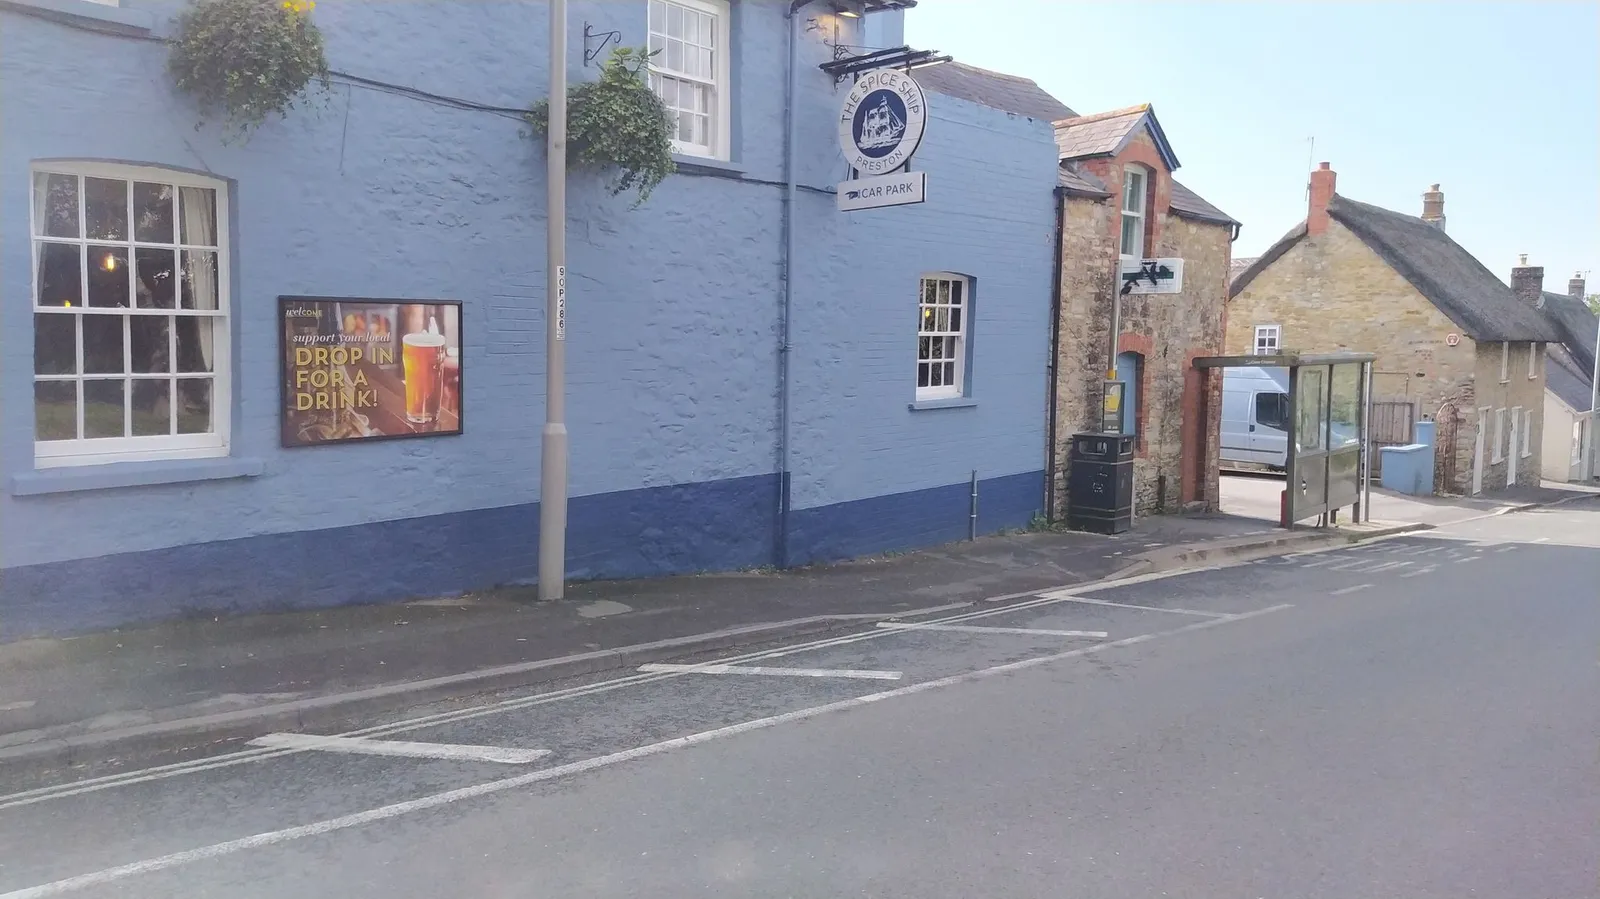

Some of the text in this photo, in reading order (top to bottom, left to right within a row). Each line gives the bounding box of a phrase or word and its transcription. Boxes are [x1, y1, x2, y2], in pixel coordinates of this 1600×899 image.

[841, 72, 920, 124] THE SPICE SHIP
[855, 149, 903, 171] PRESTON
[861, 182, 913, 199] CAR PARK
[292, 331, 391, 346] support your local
[295, 347, 393, 366] DROP IN
[296, 368, 368, 389] FOR A
[296, 389, 379, 411] DRINK!
